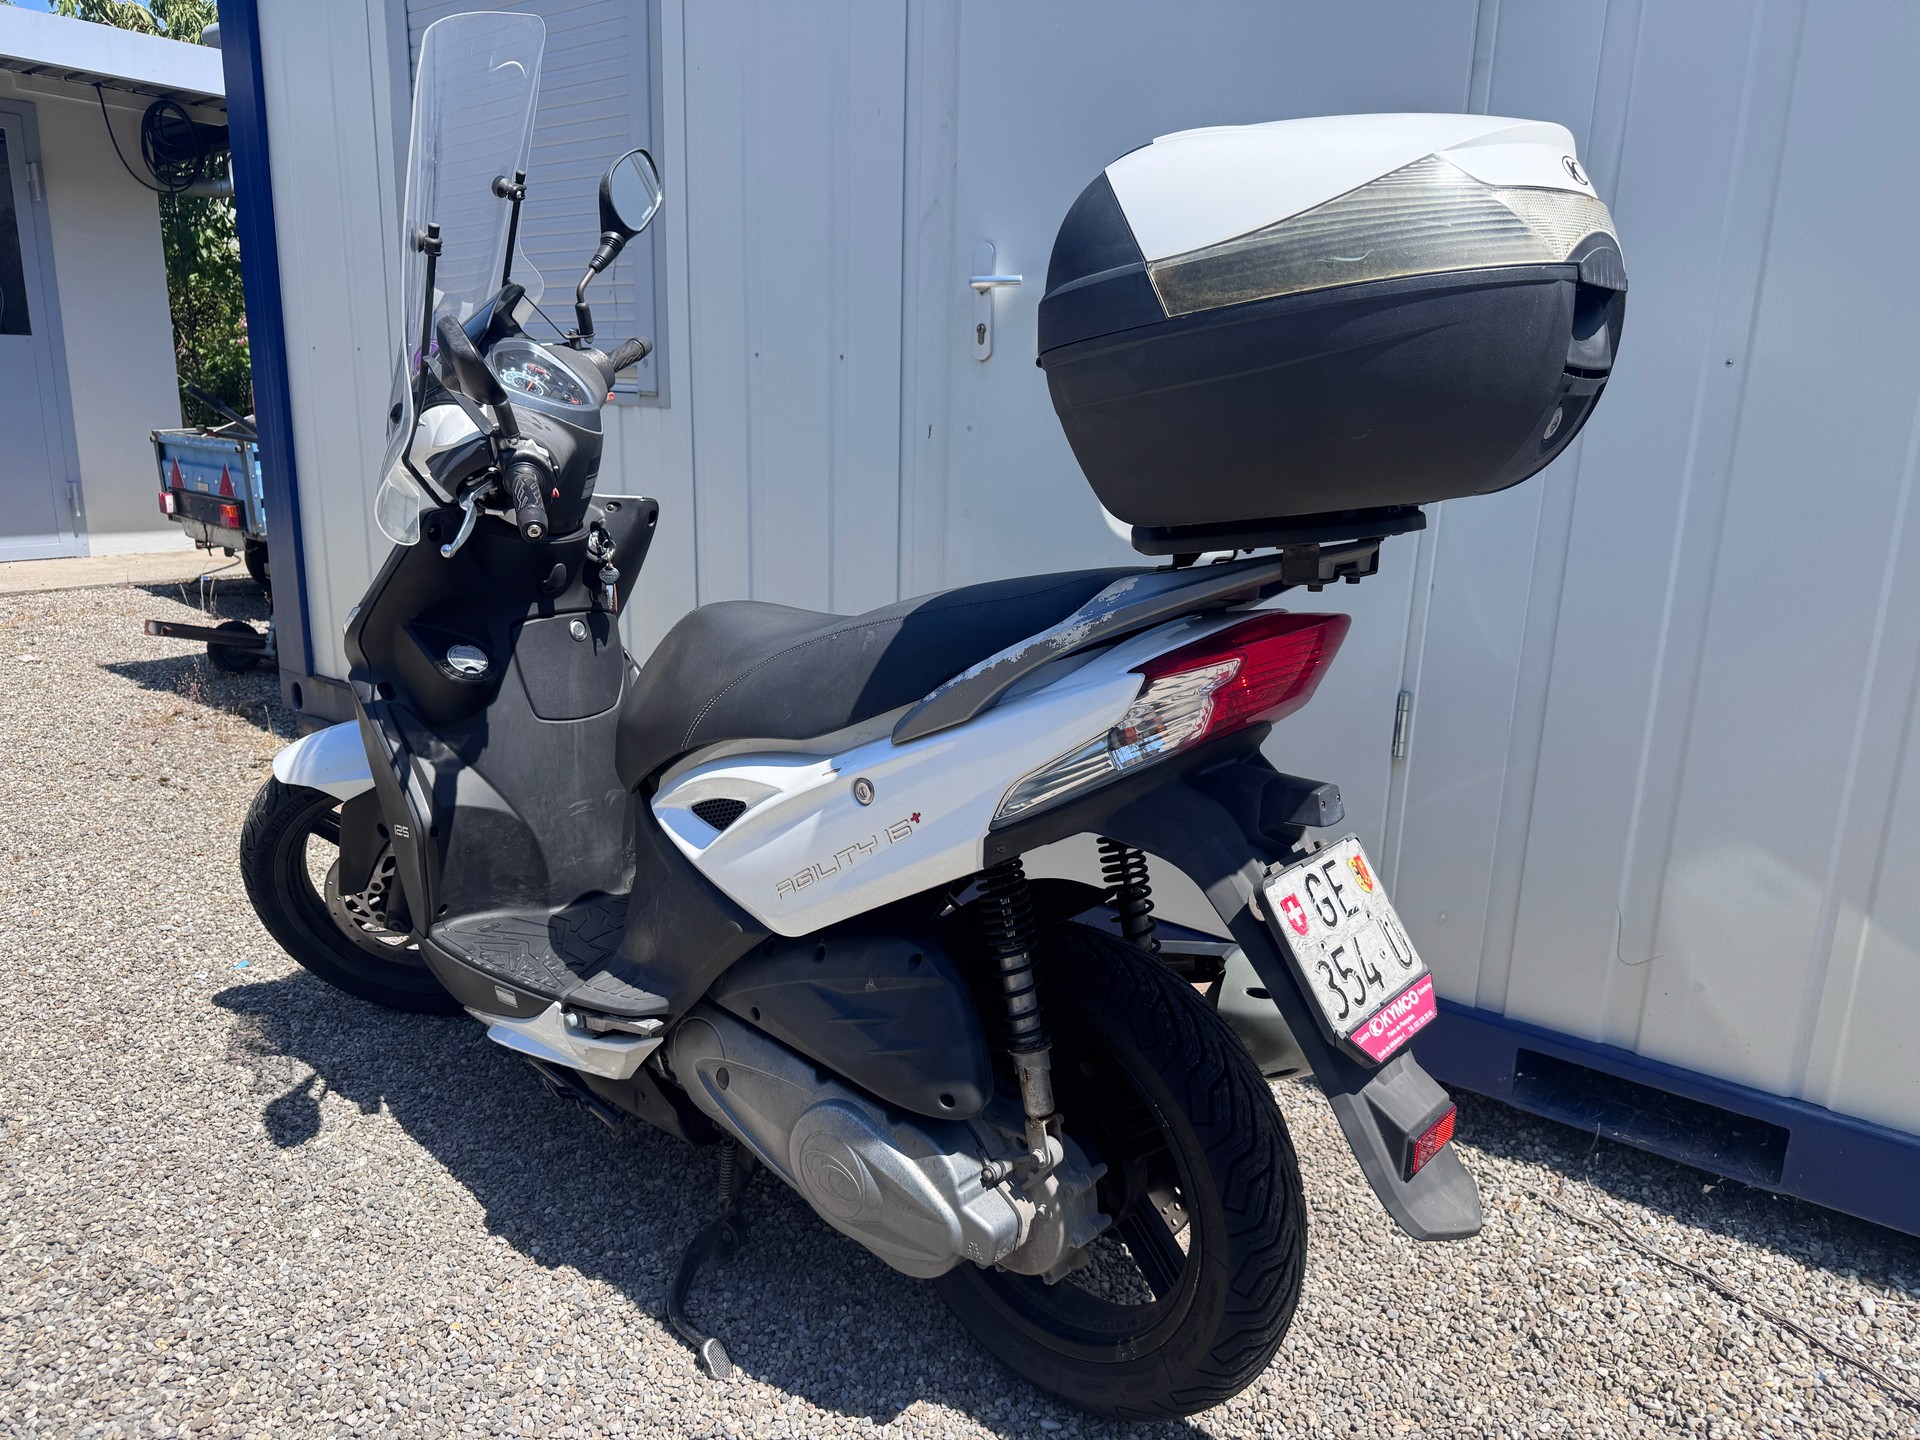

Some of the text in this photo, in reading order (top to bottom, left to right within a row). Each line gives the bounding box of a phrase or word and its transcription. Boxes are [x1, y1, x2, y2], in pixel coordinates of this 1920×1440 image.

[775, 835, 878, 900] AGILITY
[1303, 859, 1360, 928] GE
[1316, 936, 1385, 1021] 354
[1380, 990, 1419, 1028] KYMCO
